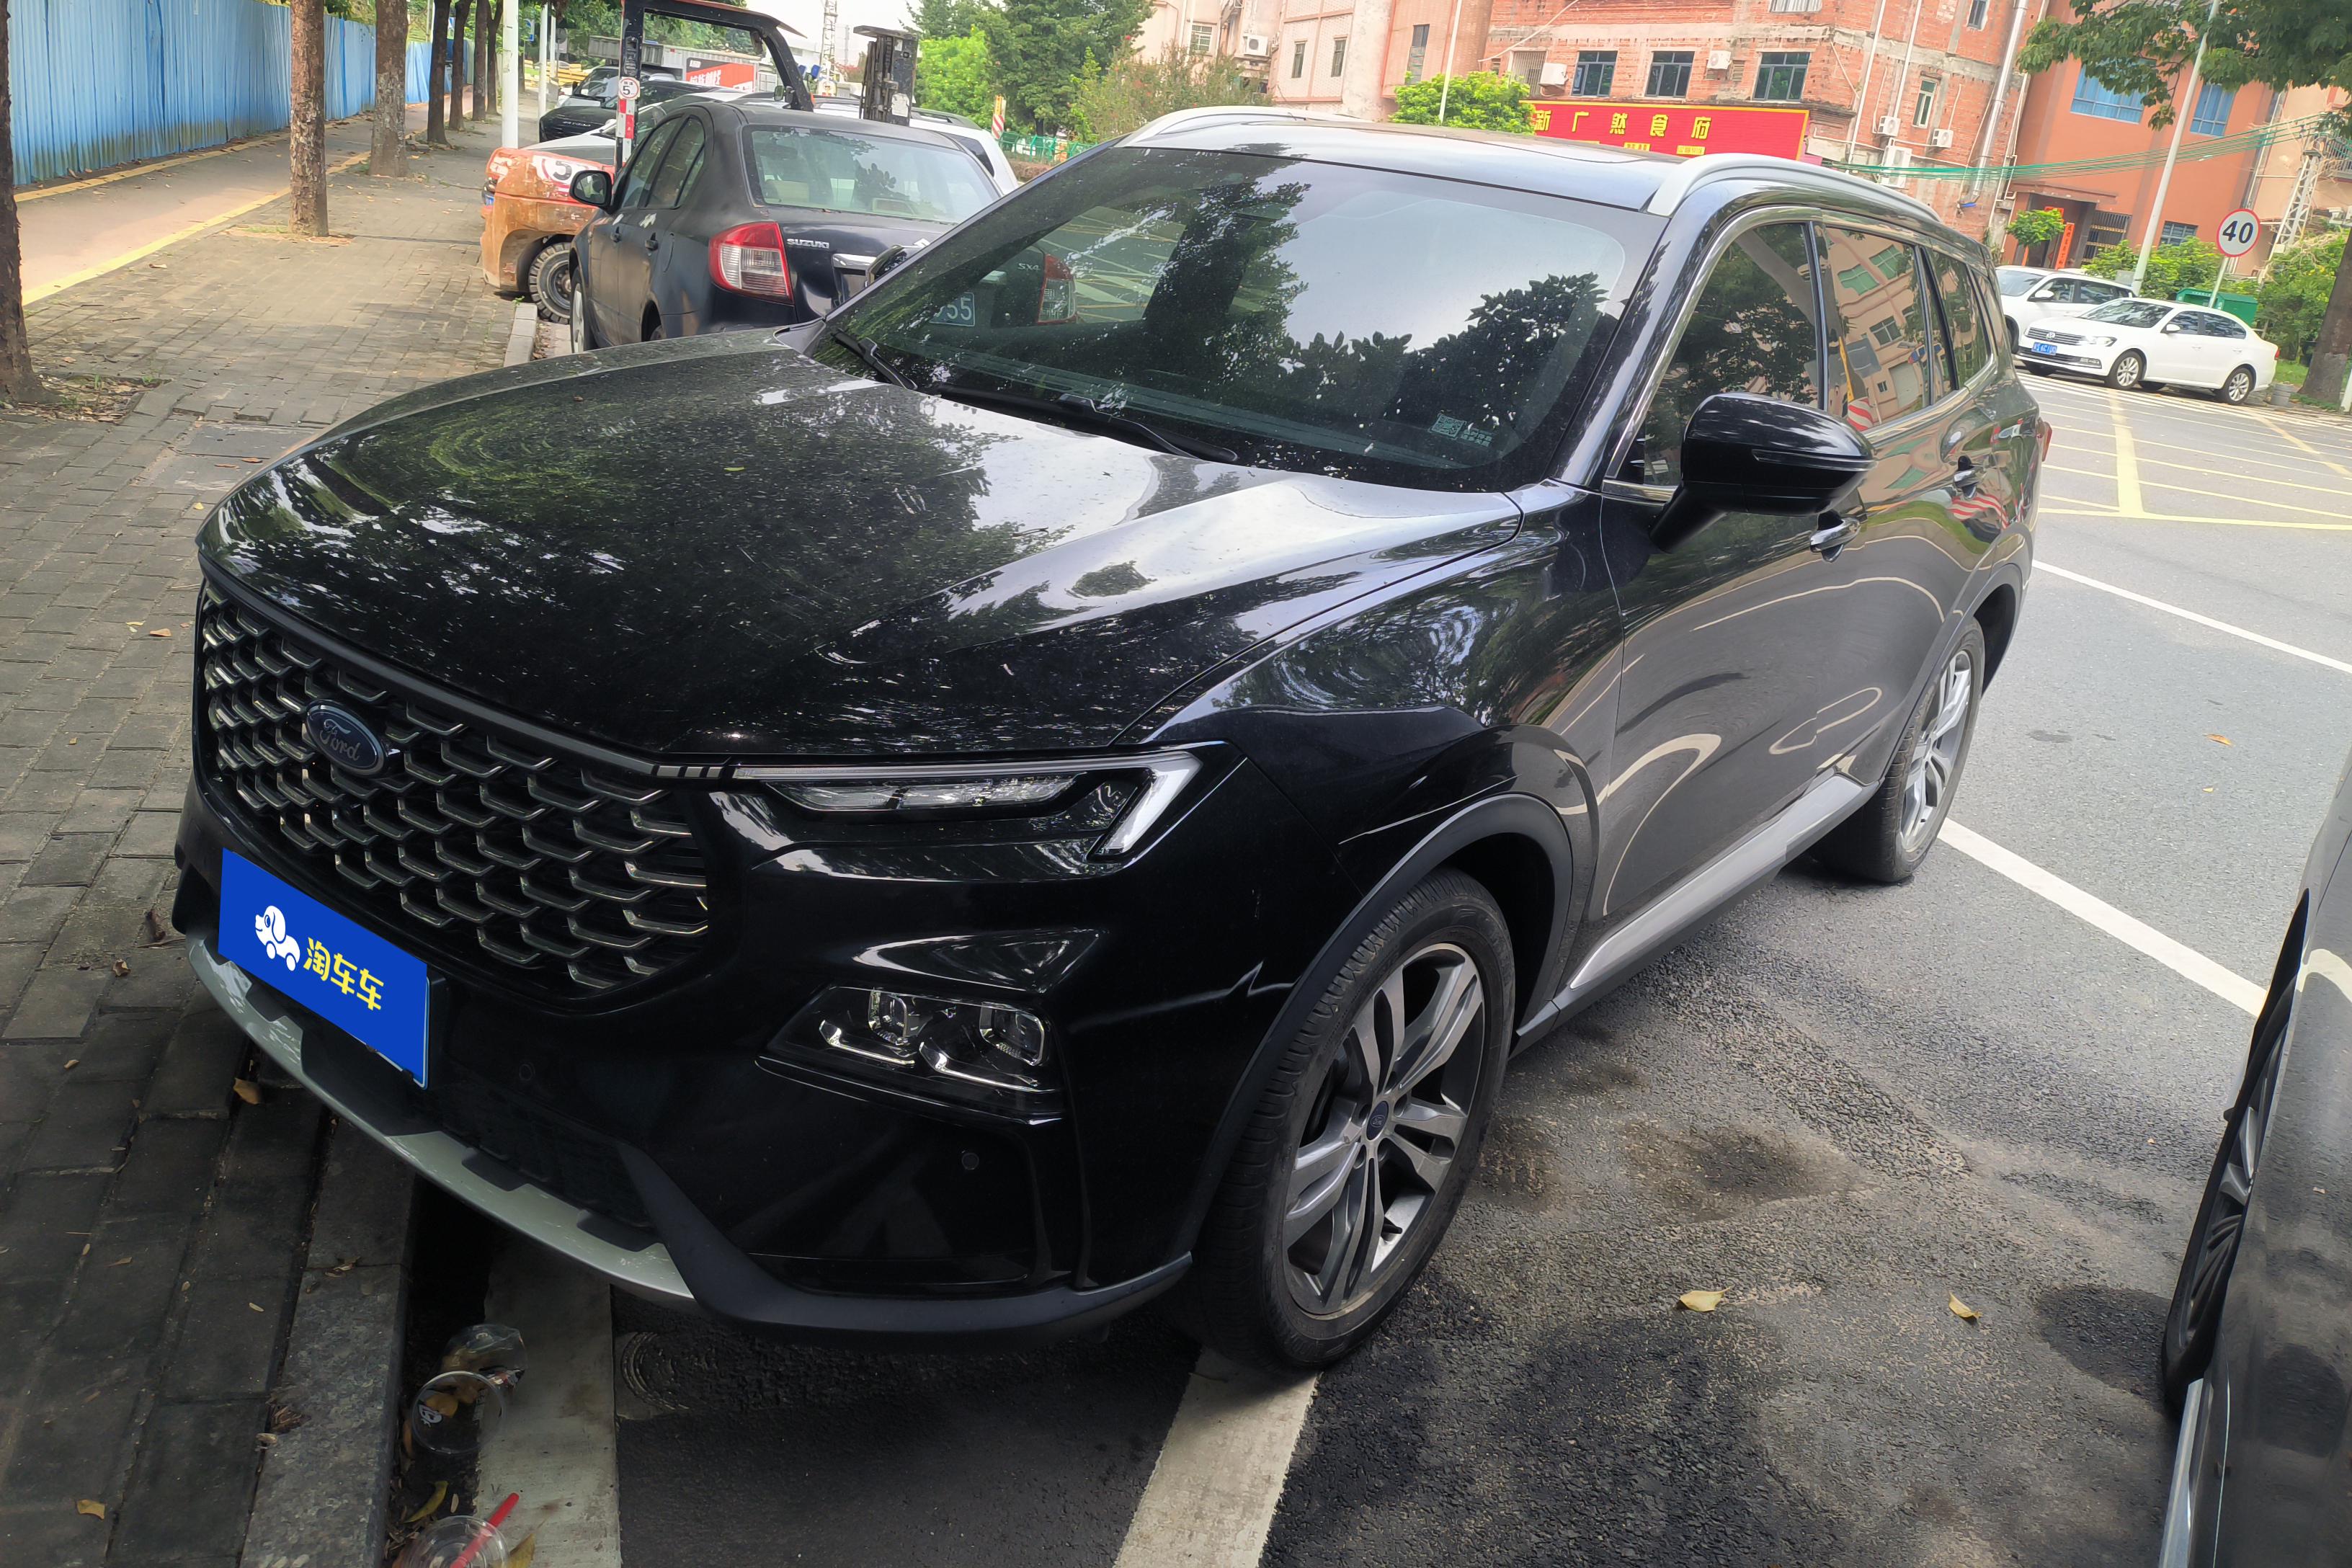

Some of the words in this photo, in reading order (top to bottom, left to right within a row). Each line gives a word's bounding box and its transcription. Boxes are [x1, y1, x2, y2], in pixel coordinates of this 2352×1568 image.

[623, 86, 631, 95] 5
[2222, 220, 2253, 244] 40
[787, 239, 829, 249] SUZUKI
[320, 718, 361, 761] Ford
